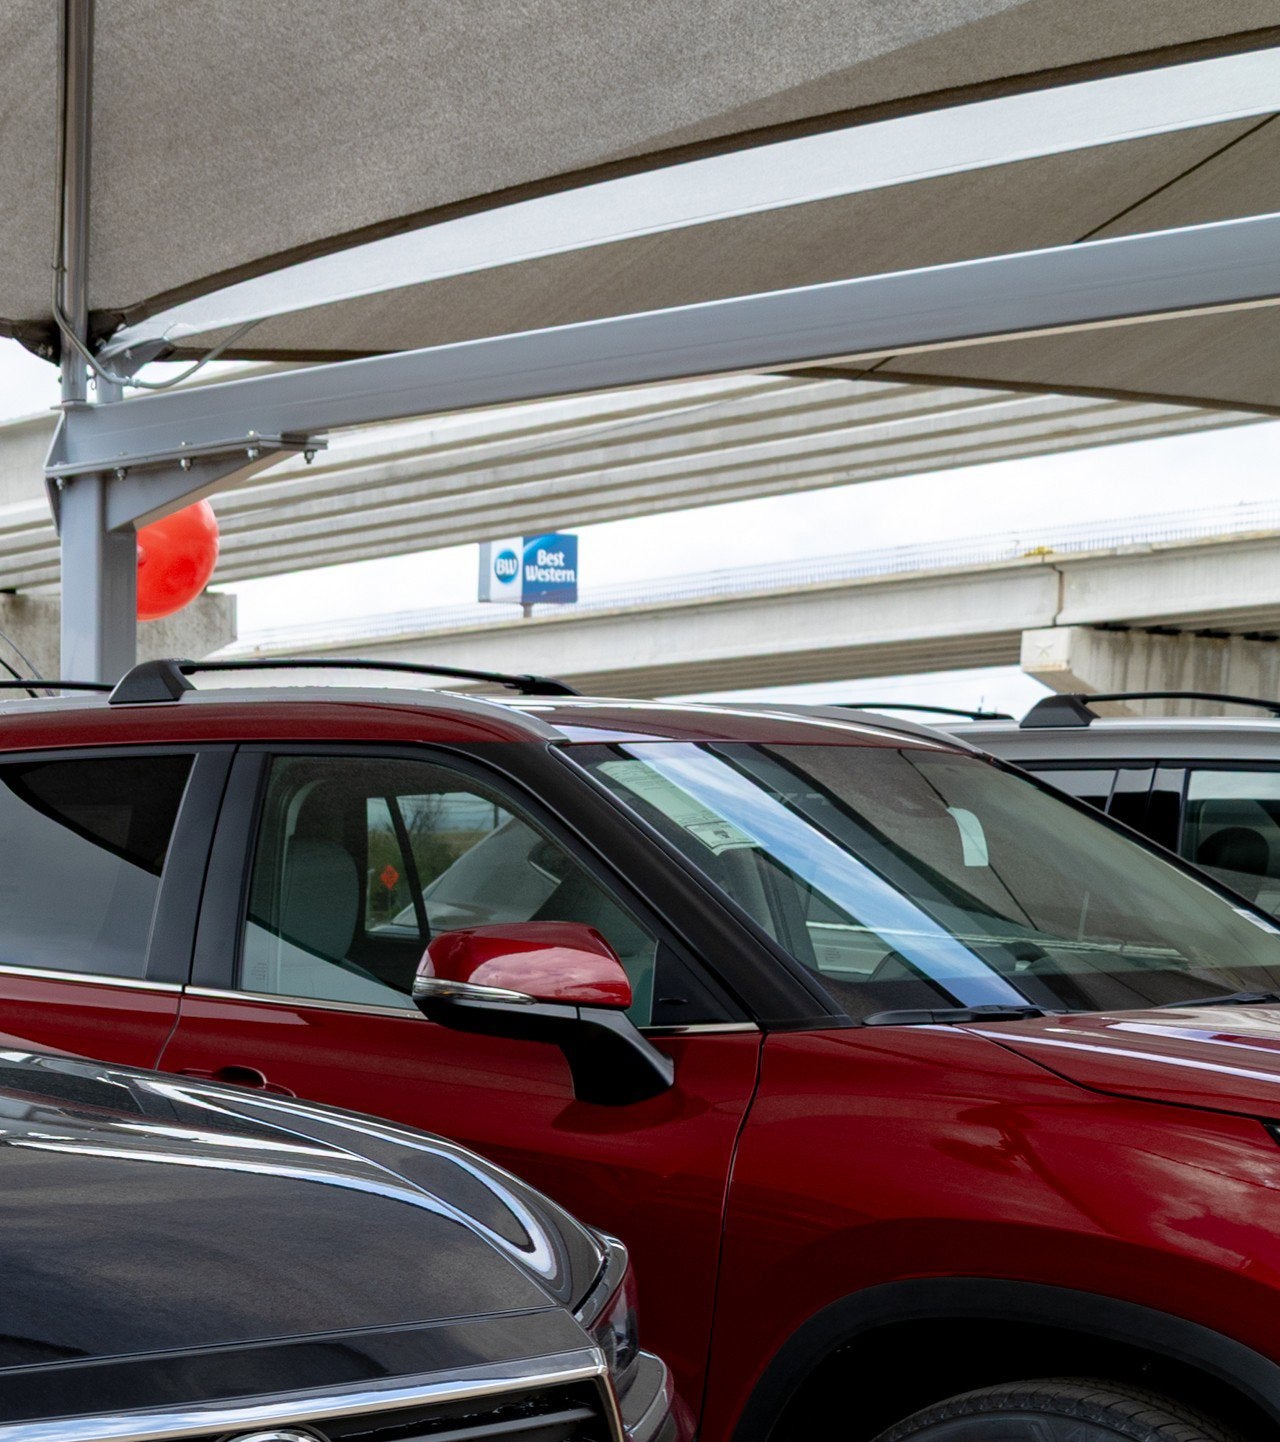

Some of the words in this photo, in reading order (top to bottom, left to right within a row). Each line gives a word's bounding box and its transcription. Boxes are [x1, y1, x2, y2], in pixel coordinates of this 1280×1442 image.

[497, 558, 517, 576] BW
[537, 549, 565, 567] Best
[525, 565, 575, 582] Western
